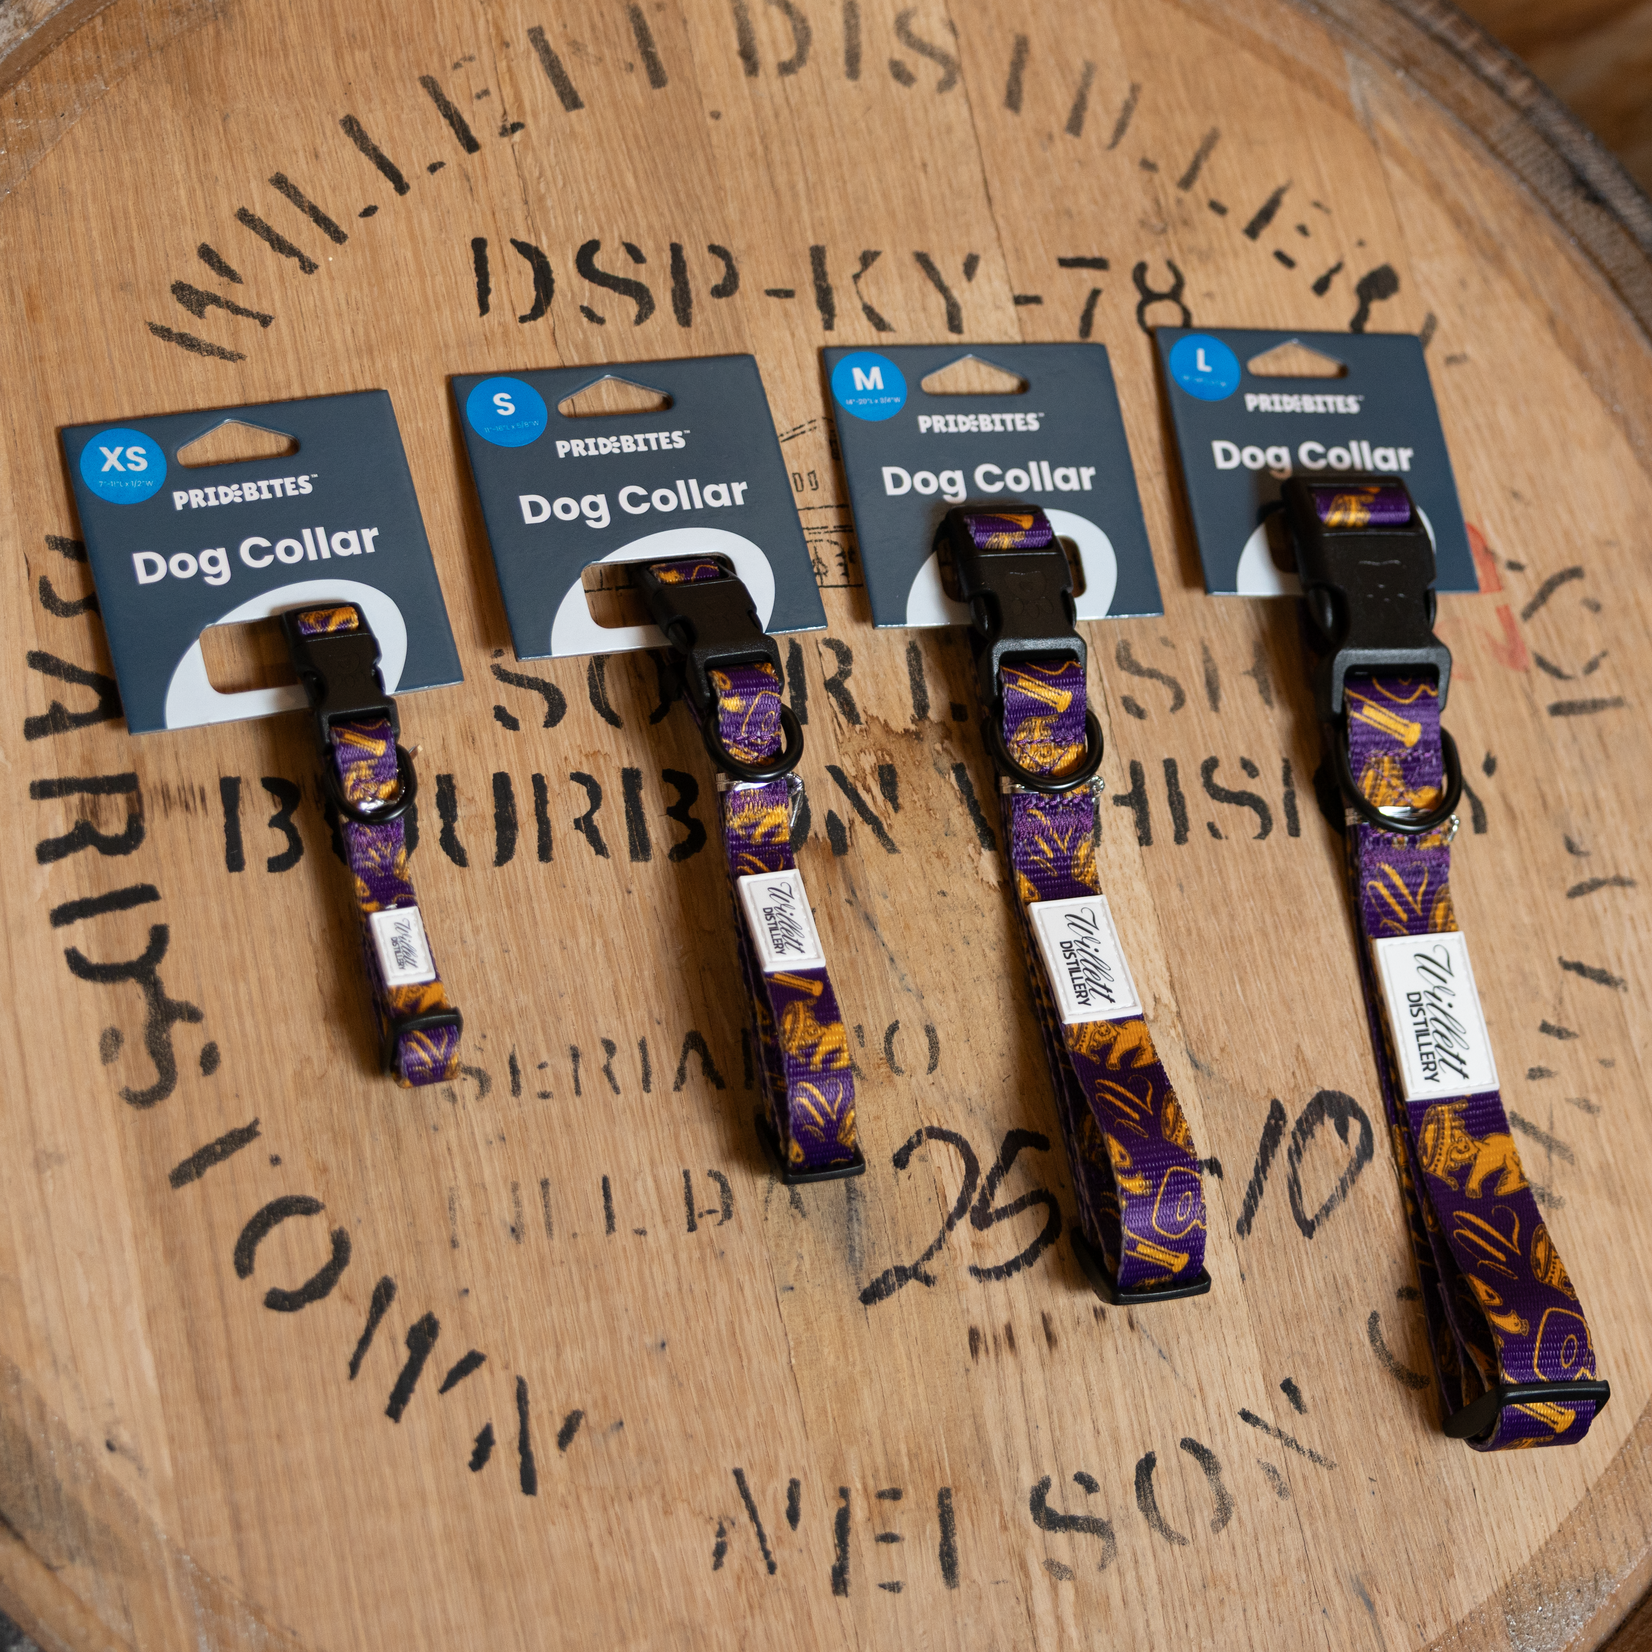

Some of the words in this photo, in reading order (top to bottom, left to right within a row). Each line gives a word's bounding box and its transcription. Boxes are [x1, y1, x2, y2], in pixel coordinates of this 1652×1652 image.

[470, 236, 1193, 338] DSP-KY-78
[852, 366, 884, 391] M
[1196, 348, 1213, 373] L
[493, 392, 516, 416] S
[98, 446, 149, 472] XS
[882, 466, 967, 504] Dog
[974, 460, 1097, 493] Collar
[1211, 440, 1293, 480] Dog
[1298, 440, 1414, 472] Collar
[519, 493, 611, 529] Dog
[618, 478, 748, 515] Collar
[132, 546, 232, 586] Dog
[239, 526, 380, 569] Collar
[490, 637, 863, 732] SOR
[220, 765, 901, 873] BOURBN
[393, 917, 419, 969] Willett
[762, 907, 787, 955] DISTILLERY
[767, 881, 806, 954] Willett
[1059, 940, 1092, 1007] DISTILLERY
[1064, 906, 1116, 1004] Willett
[1406, 990, 1441, 1083] DISTILLERY
[1413, 943, 1470, 1080] Willett
